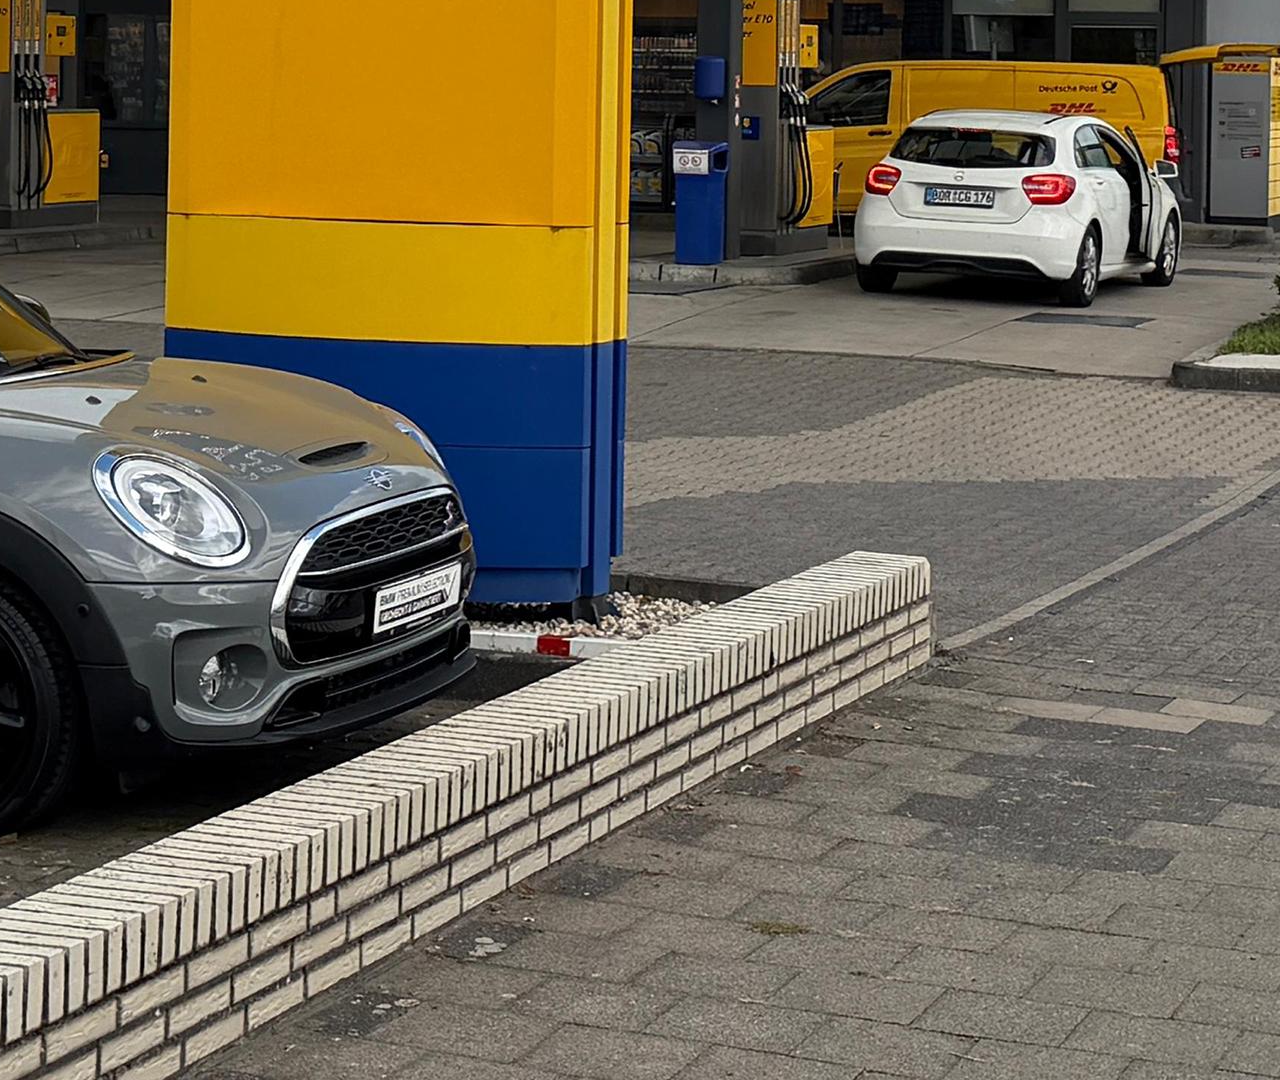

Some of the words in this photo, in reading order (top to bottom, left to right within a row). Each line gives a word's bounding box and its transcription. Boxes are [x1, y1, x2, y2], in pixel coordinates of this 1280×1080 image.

[1220, 62, 1261, 73] DHL
[1039, 84, 1078, 93] Deutsche
[1079, 84, 1098, 93] Post
[1048, 102, 1097, 115] DHL
